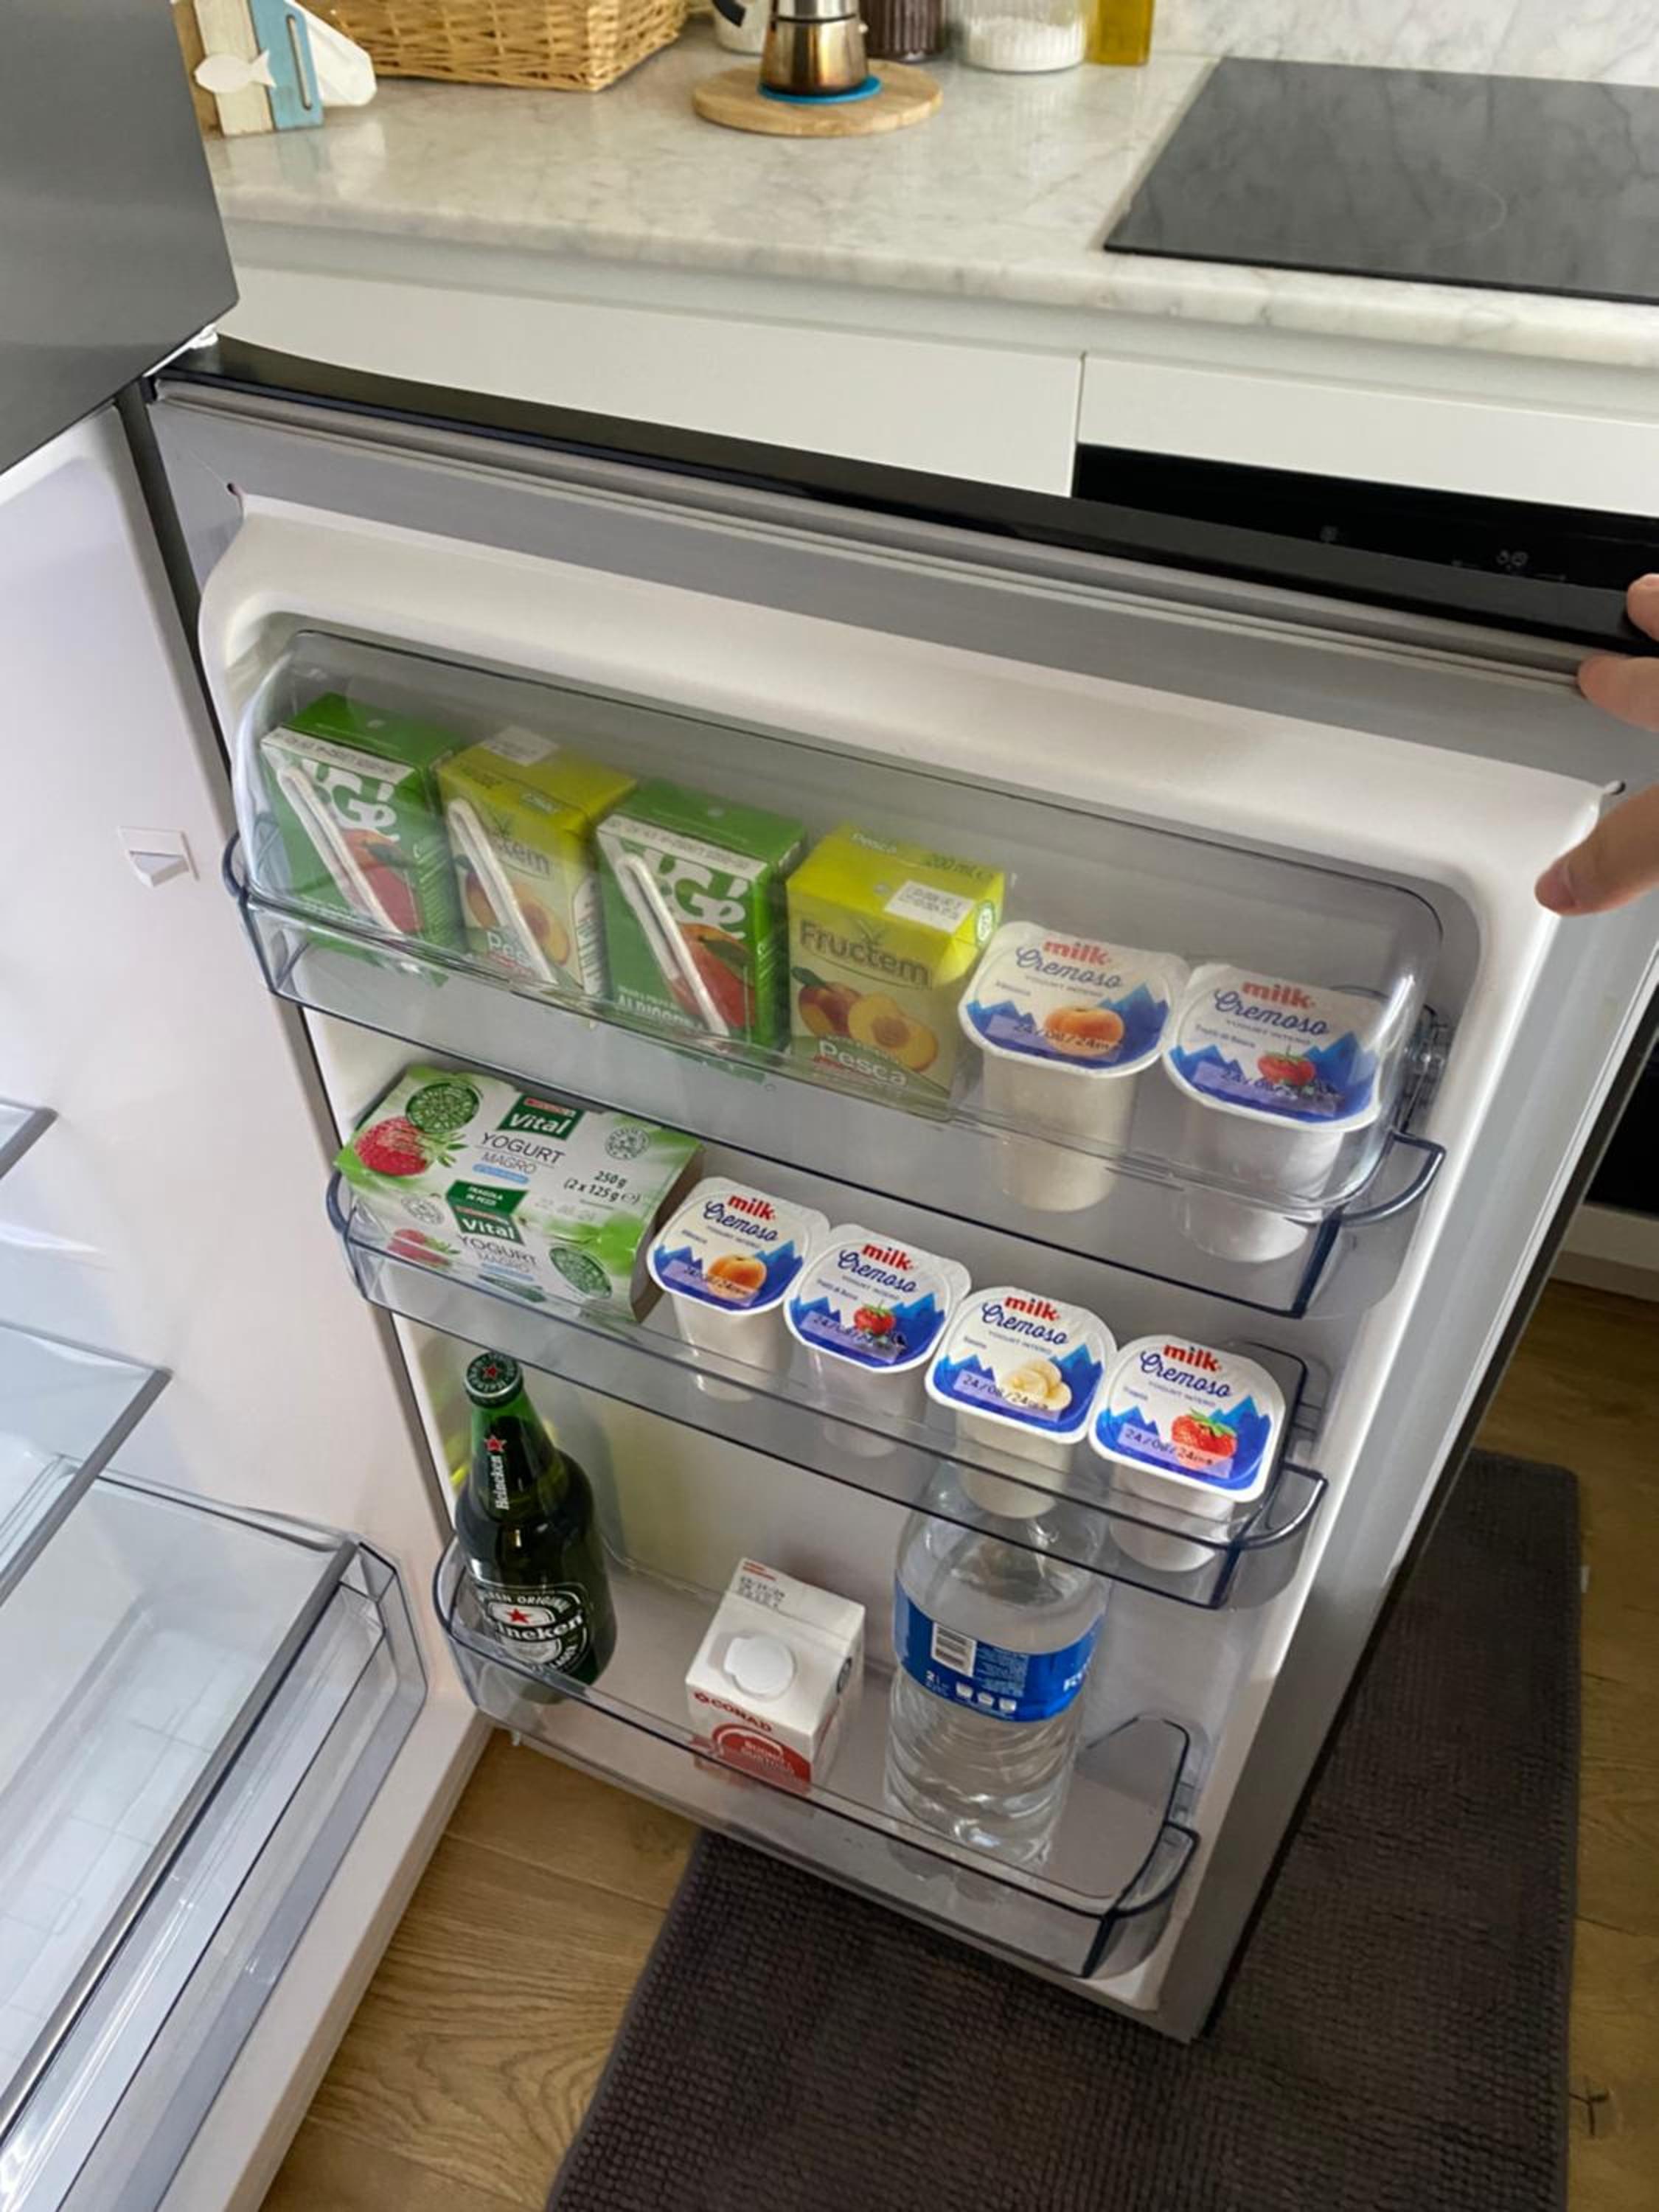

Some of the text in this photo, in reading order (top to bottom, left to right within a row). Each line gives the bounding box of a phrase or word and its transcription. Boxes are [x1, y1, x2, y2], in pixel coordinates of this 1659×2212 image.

[799, 919, 933, 991] Fructem
[1015, 945, 1123, 990] Cremoso
[1043, 939, 1109, 967] milk
[1242, 981, 1312, 1009] milk
[1214, 988, 1330, 1036] Cremoso
[817, 1038, 908, 1088] Pesca
[508, 1113, 572, 1135] Vital
[481, 1132, 566, 1166] YOGURT
[481, 1151, 538, 1175] MAGRO
[588, 1183, 609, 1198] 125
[594, 1169, 618, 1185] 250
[703, 1200, 779, 1242] Cremoso
[727, 1194, 774, 1221] milk
[462, 1217, 515, 1240] Vital
[457, 1234, 537, 1266] YOGURT
[861, 1243, 910, 1271] milk
[837, 1249, 917, 1293] Cremoso
[981, 1302, 1069, 1345] Cremoso
[1004, 1296, 1057, 1322] milk
[1163, 1344, 1220, 1372] milk
[1140, 1351, 1231, 1398] Cremoso
[489, 1455, 510, 1511] Heineken
[496, 1612, 584, 1641] ineken
[711, 1698, 773, 1733] CONAD
